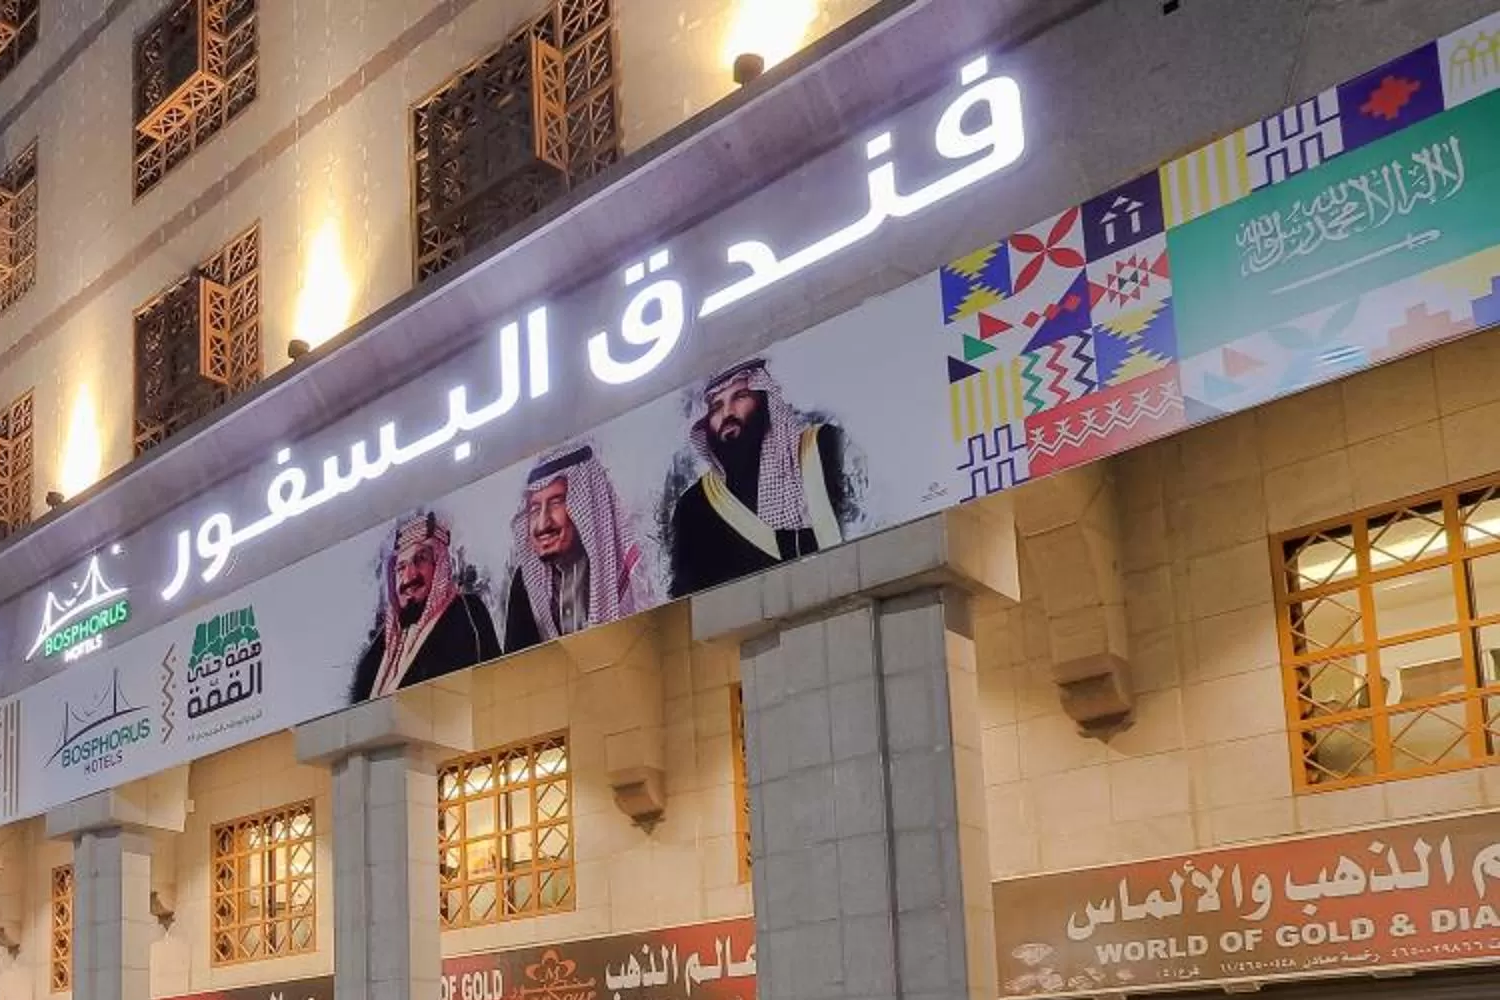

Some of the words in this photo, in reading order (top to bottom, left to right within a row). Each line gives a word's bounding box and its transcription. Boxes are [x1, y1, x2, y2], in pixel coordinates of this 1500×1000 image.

[587, 55, 1026, 386] فندق
[160, 307, 550, 601] البسفور
[45, 600, 128, 656] BOSPHORUS
[61, 718, 151, 768] BOSPHORUS
[84, 750, 123, 776] HOTELS
[1285, 835, 1455, 916] الذهب
[1095, 934, 1209, 965] WORLD
[1218, 928, 1263, 953] OF
[1275, 917, 1376, 948] GOLD
[1389, 913, 1417, 937] &
